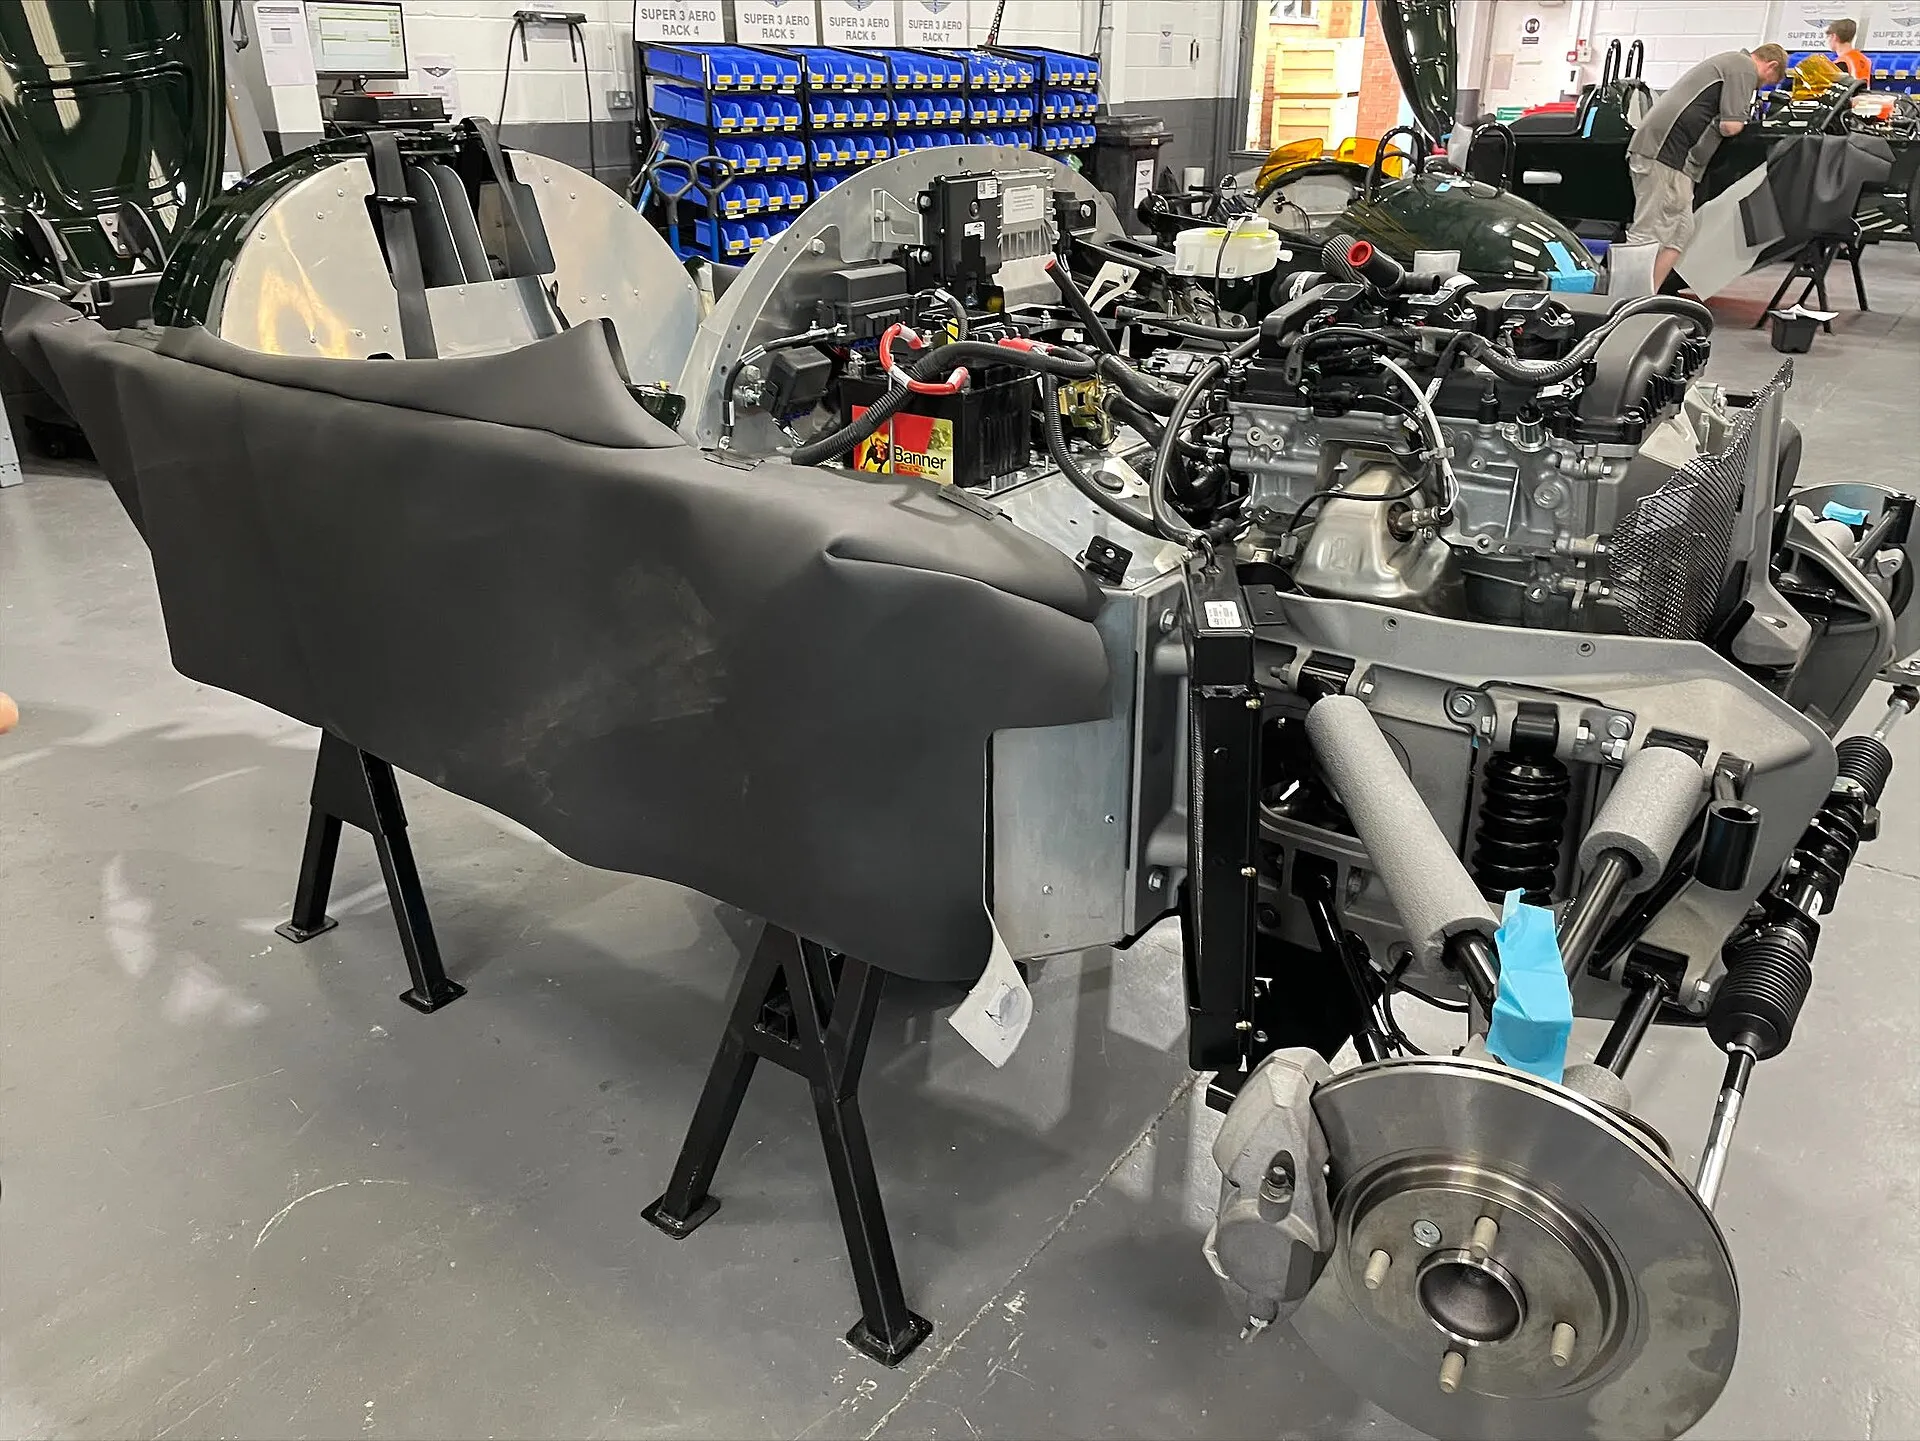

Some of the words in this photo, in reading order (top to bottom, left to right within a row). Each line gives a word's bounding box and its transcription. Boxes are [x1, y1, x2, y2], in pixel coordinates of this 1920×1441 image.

[641, 8, 677, 21] SUPER
[679, 10, 685, 21] 3
[688, 10, 716, 22] AERO
[743, 13, 775, 25] SUPER
[777, 15, 783, 25] 3
[785, 15, 810, 26] AERO
[829, 16, 858, 28] SUPER
[860, 18, 865, 28] 3
[867, 18, 890, 28] AERO
[908, 19, 933, 30] SUPER
[935, 20, 940, 30] 3
[942, 20, 963, 30] AERO
[662, 24, 691, 36] RACK
[693, 25, 700, 36] 4
[761, 28, 787, 39] RACK
[790, 29, 796, 39] 5
[1787, 31, 1817, 39] SUPER
[846, 31, 869, 41] RACK
[870, 31, 876, 41] 6
[922, 32, 943, 43] RACK
[944, 33, 950, 43] 7
[1887, 39, 1913, 47] RACK
[894, 446, 947, 470] Banner
